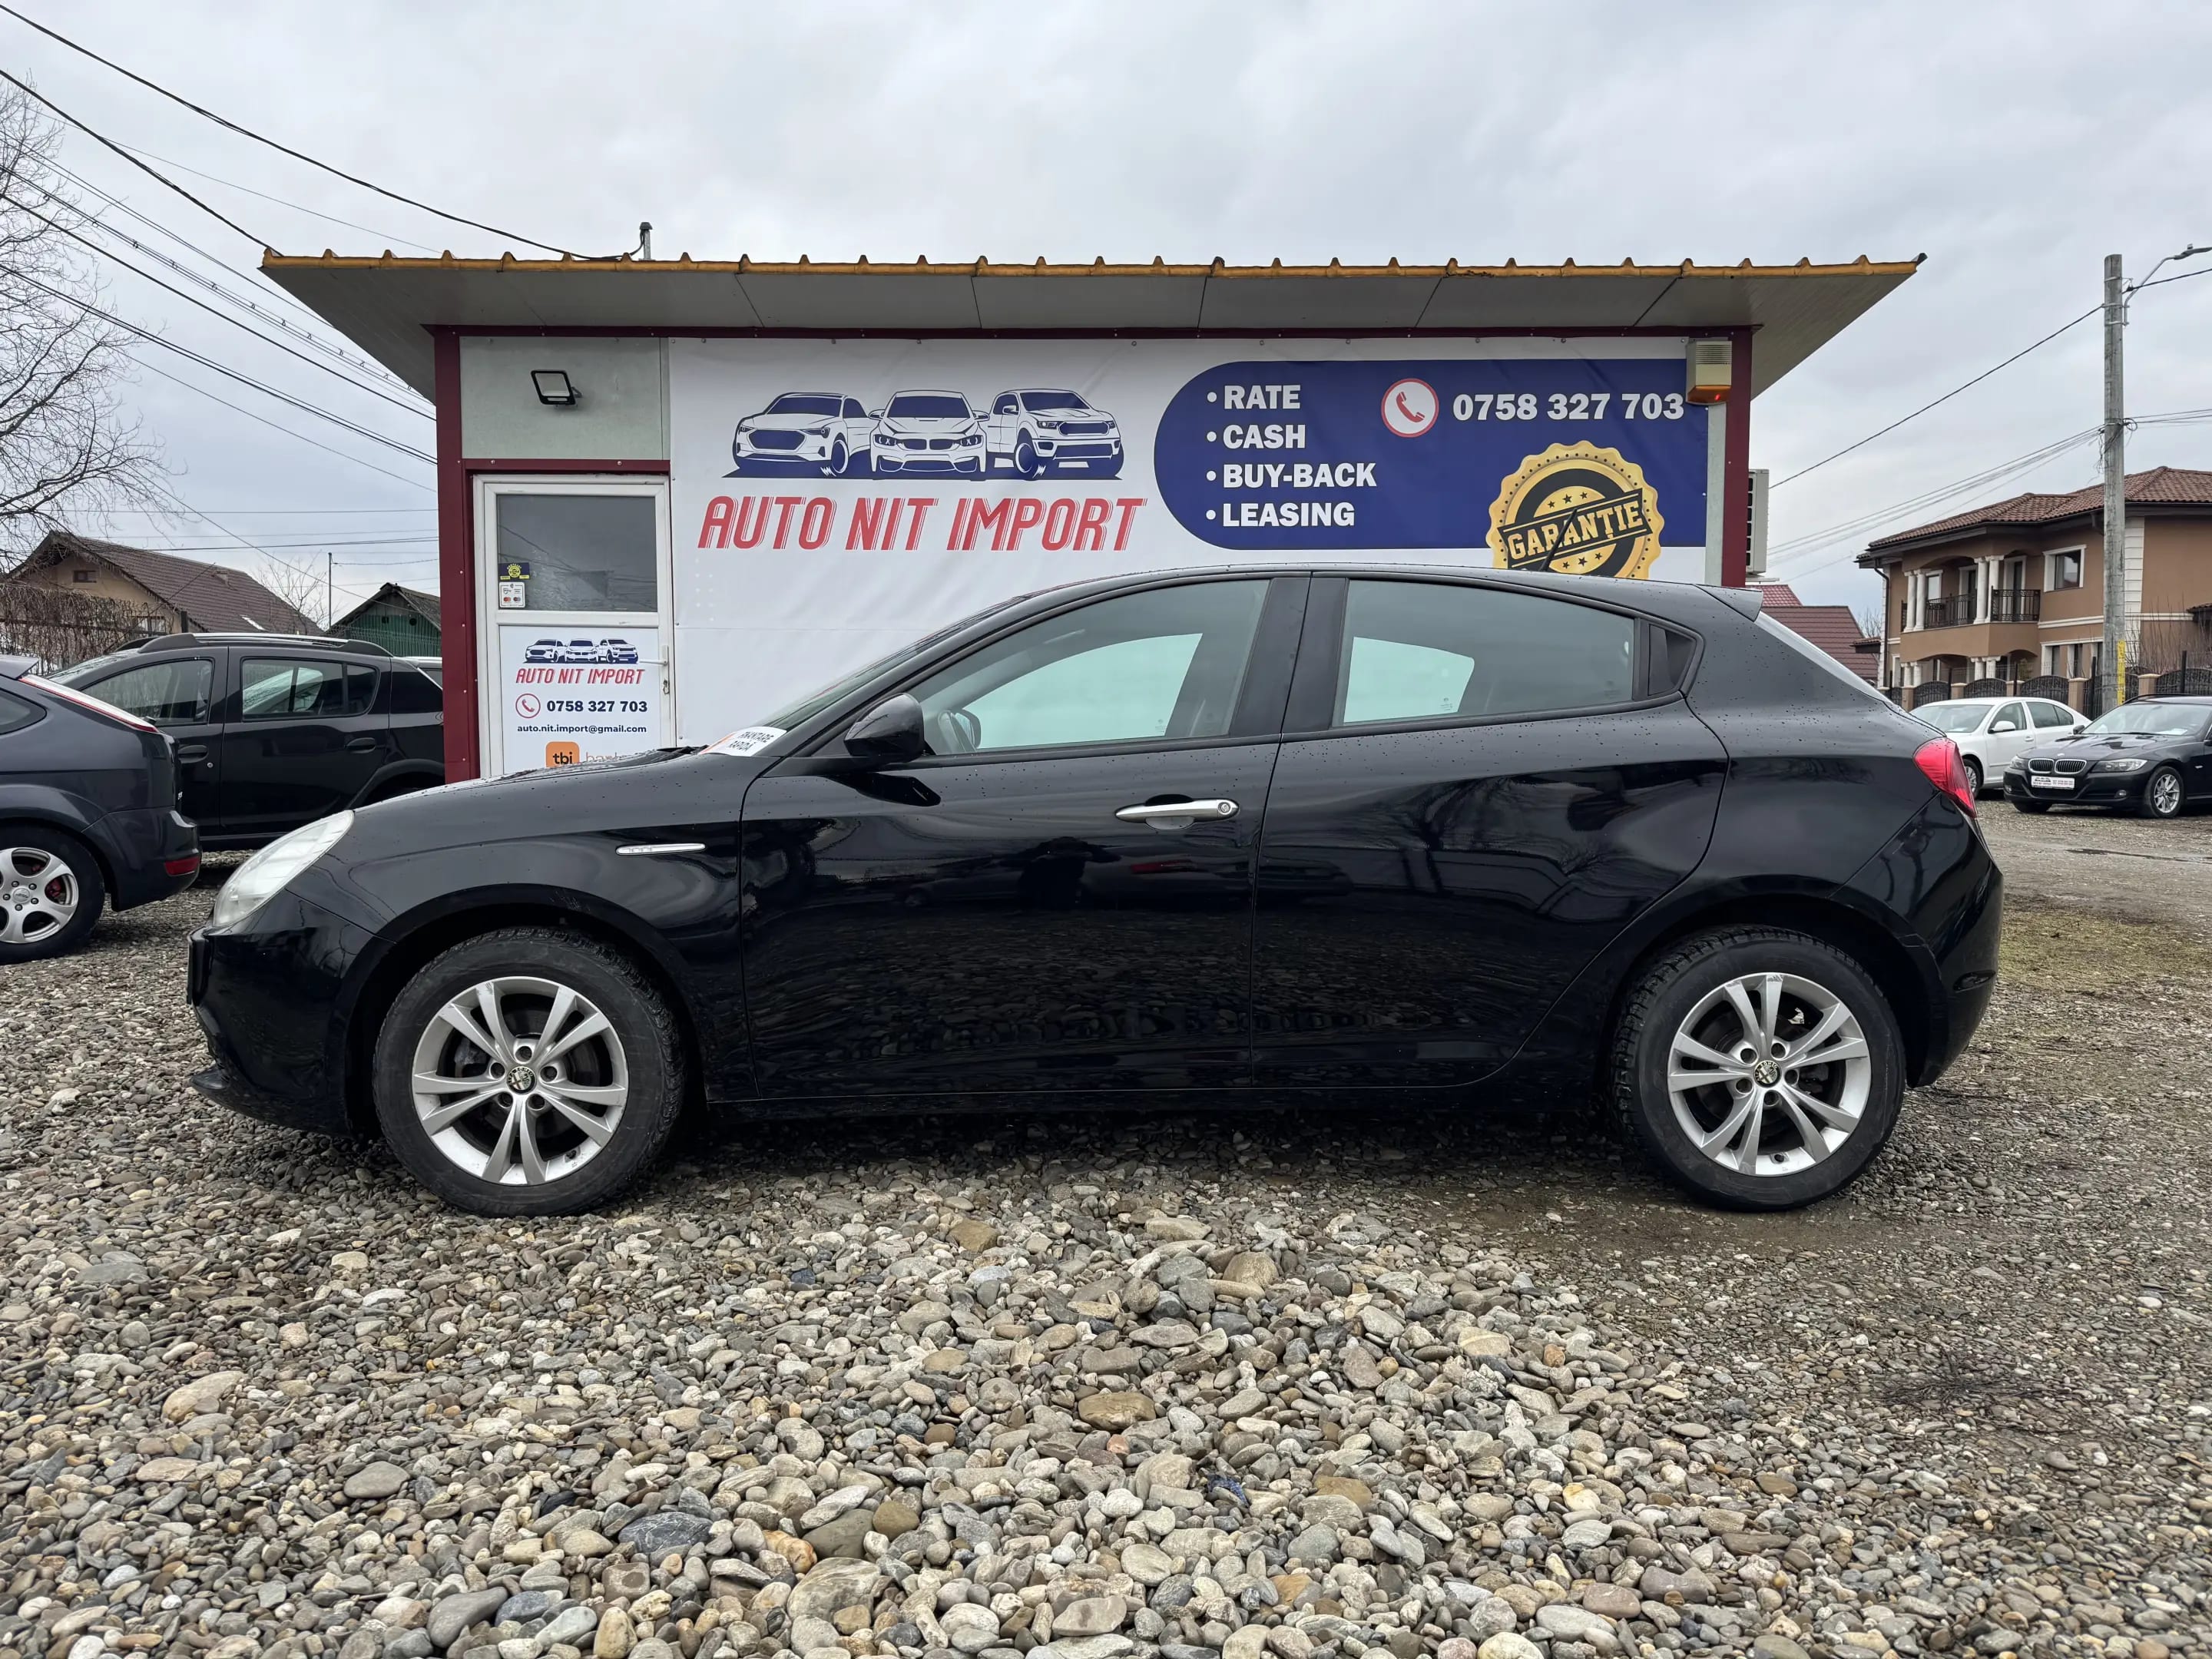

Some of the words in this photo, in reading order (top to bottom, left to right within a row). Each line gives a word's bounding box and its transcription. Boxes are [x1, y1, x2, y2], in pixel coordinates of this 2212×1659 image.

[1224, 384, 1301, 410] RATE
[1452, 392, 1538, 421] 0758
[1546, 392, 1611, 421] 327
[1621, 392, 1685, 420] 703
[1222, 423, 1306, 450] CASH
[1223, 462, 1378, 489] BUY-BACK
[697, 495, 837, 551] AUTO
[845, 497, 938, 552] NIT
[945, 497, 1147, 552] IMPORT
[1222, 501, 1356, 528] LEASING
[515, 668, 555, 684] AUTO
[558, 668, 584, 684] NIT
[587, 668, 646, 684] IMPORT
[546, 700, 584, 713] 0758
[588, 700, 615, 713] 327
[620, 700, 647, 713] 703
[517, 724, 647, 734] auto.nit.import@gmail.com
[552, 751, 573, 765] tbi
